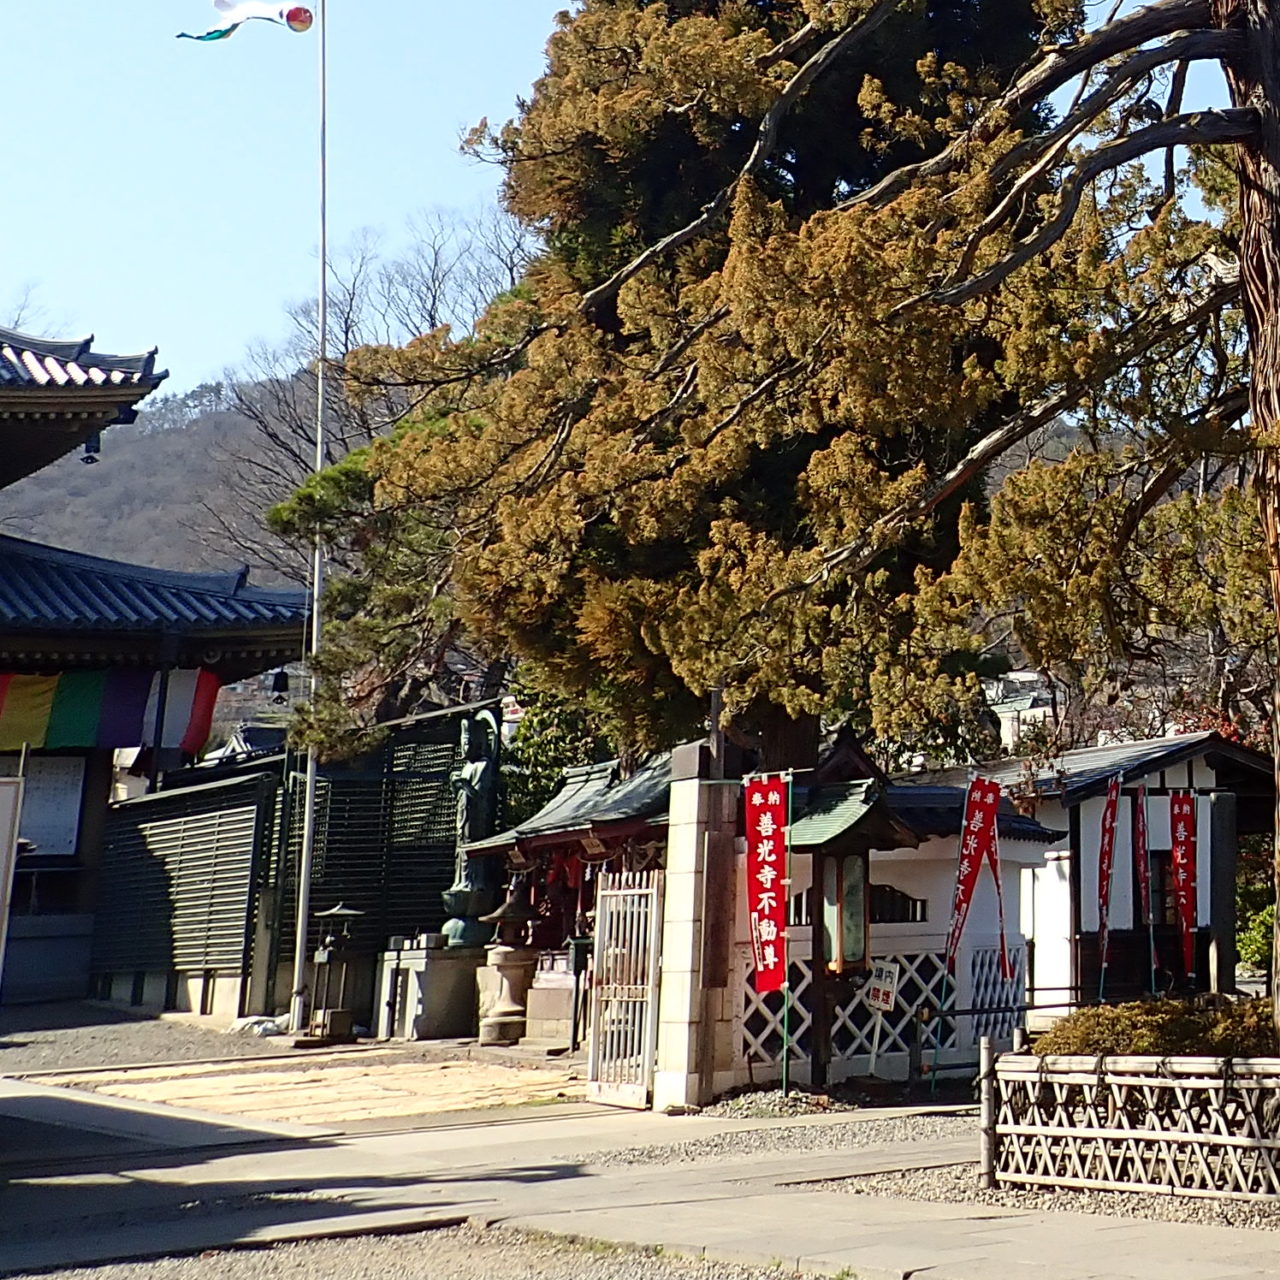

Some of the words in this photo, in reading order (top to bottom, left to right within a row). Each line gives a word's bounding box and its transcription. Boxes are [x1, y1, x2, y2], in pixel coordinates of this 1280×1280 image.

[751, 791, 781, 806] 奉納
[755, 811, 779, 970] 善光寺不動尊
[1175, 821, 1188, 933] 善光寺不
